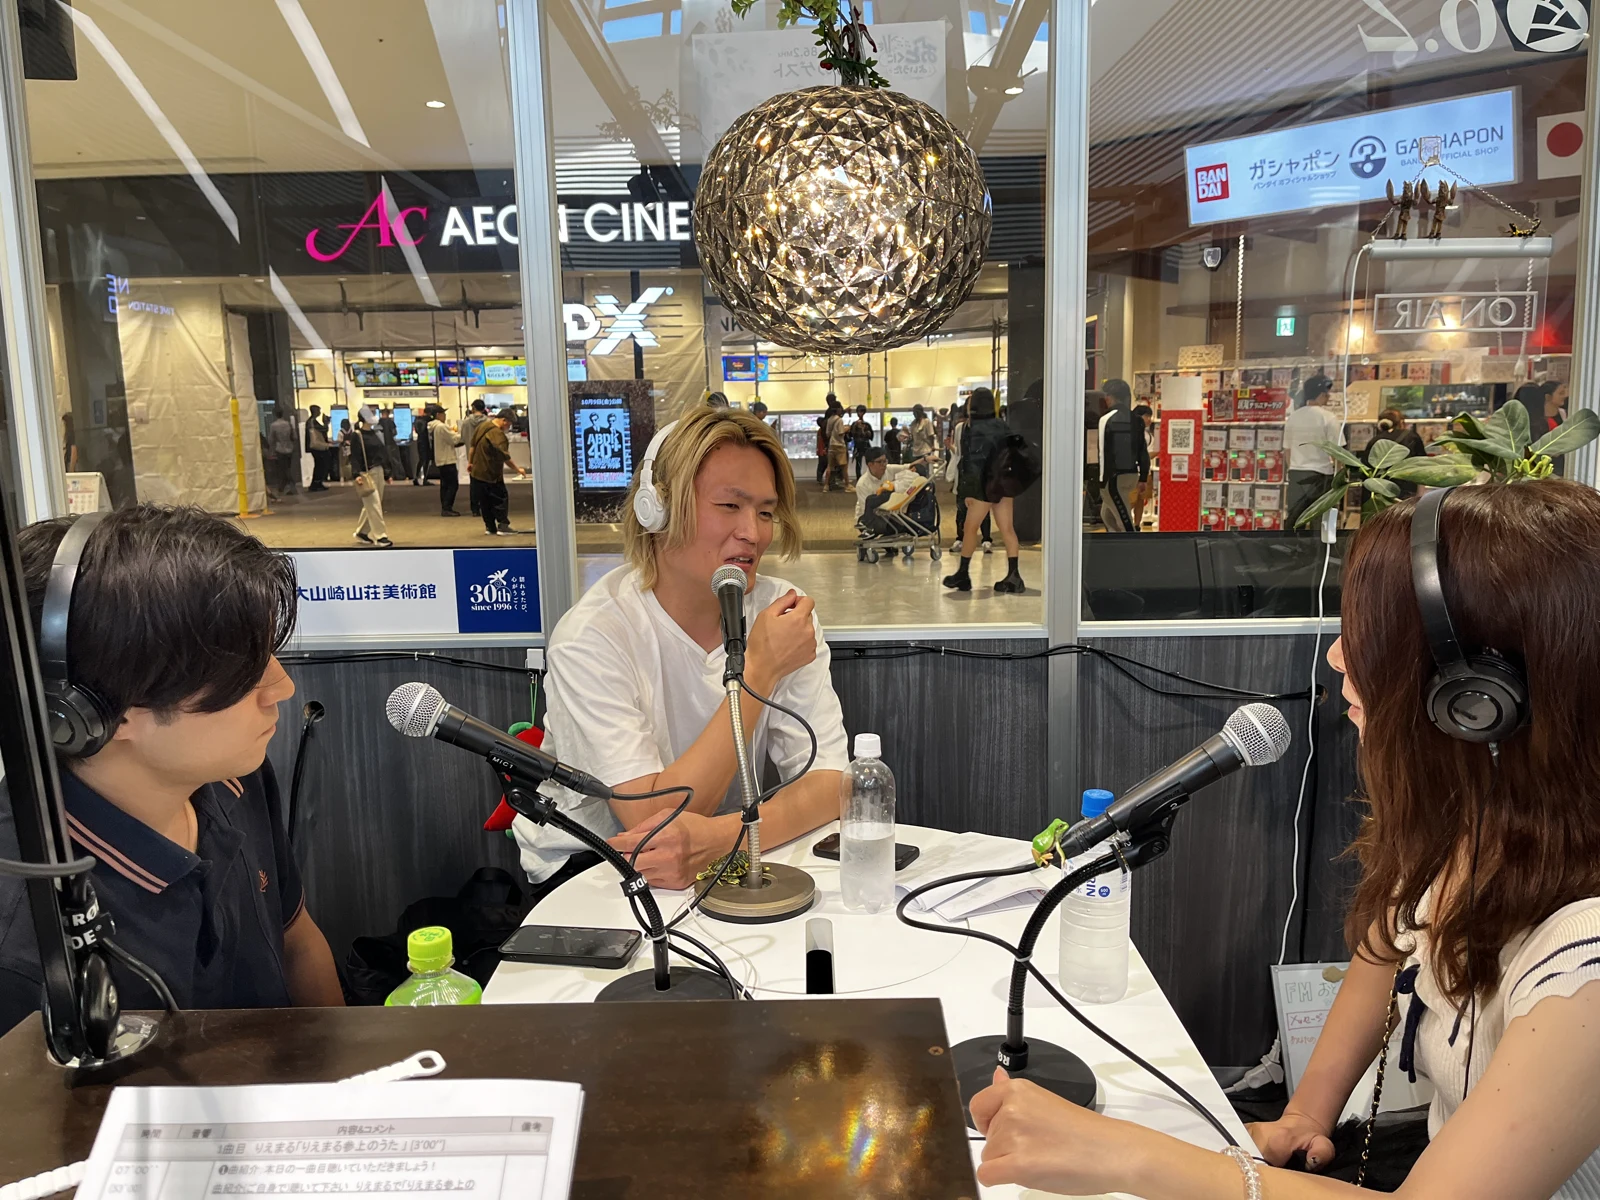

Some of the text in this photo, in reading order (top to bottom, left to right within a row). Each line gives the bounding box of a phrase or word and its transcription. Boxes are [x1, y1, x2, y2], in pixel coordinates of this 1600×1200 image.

[1395, 125, 1504, 156] GAHAPON
[1197, 166, 1227, 186] BAN
[1249, 149, 1340, 181] ガシャポン
[1198, 182, 1222, 199] DAI
[583, 201, 695, 242] CINE
[469, 583, 512, 604] 30th
[470, 603, 512, 611] since 1996
[1284, 981, 1313, 1004] FM
